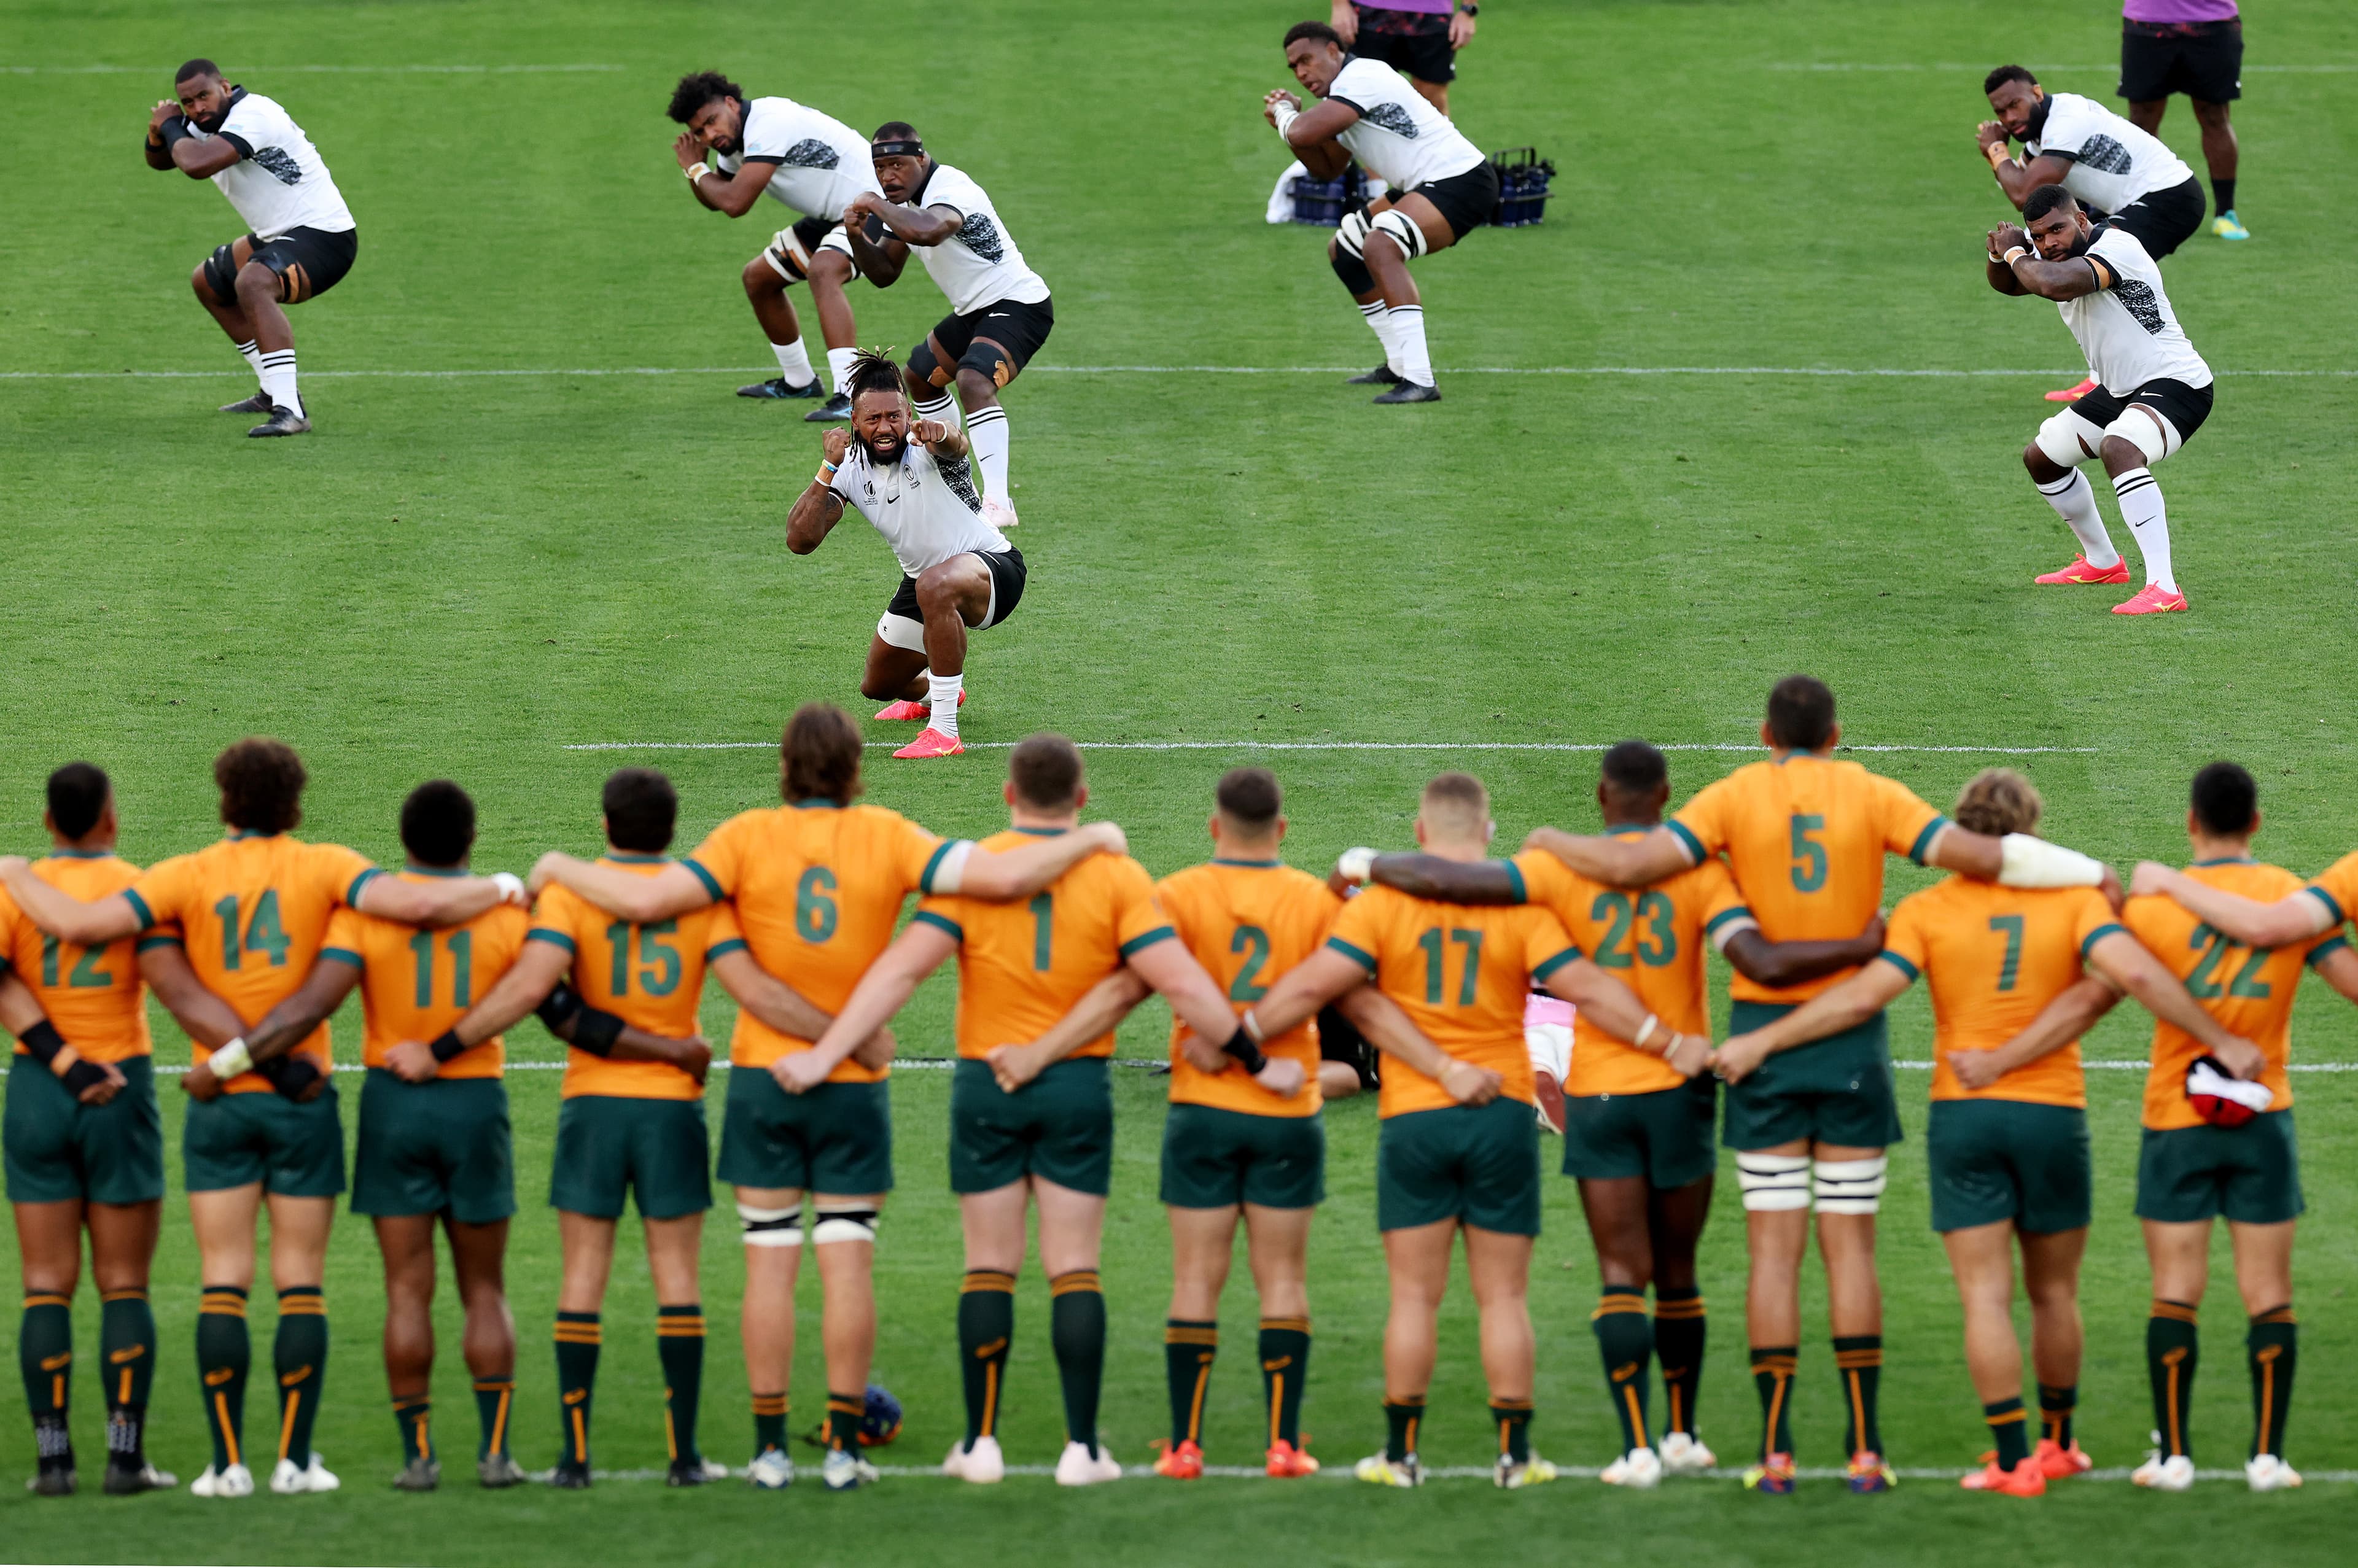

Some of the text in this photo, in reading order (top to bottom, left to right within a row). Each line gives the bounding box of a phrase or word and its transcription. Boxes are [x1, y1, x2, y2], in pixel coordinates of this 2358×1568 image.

[1792, 815, 1826, 892] 5
[216, 890, 290, 970] 14
[797, 868, 837, 942] 6
[1030, 894, 1052, 971] 1
[1592, 891, 1676, 968] 23
[411, 929, 470, 1007] 11
[607, 918, 681, 995] 15
[1230, 926, 1269, 1001] 2
[1420, 928, 1482, 1005] 17
[1990, 917, 2024, 990] 7
[2184, 922, 2270, 998] 22
